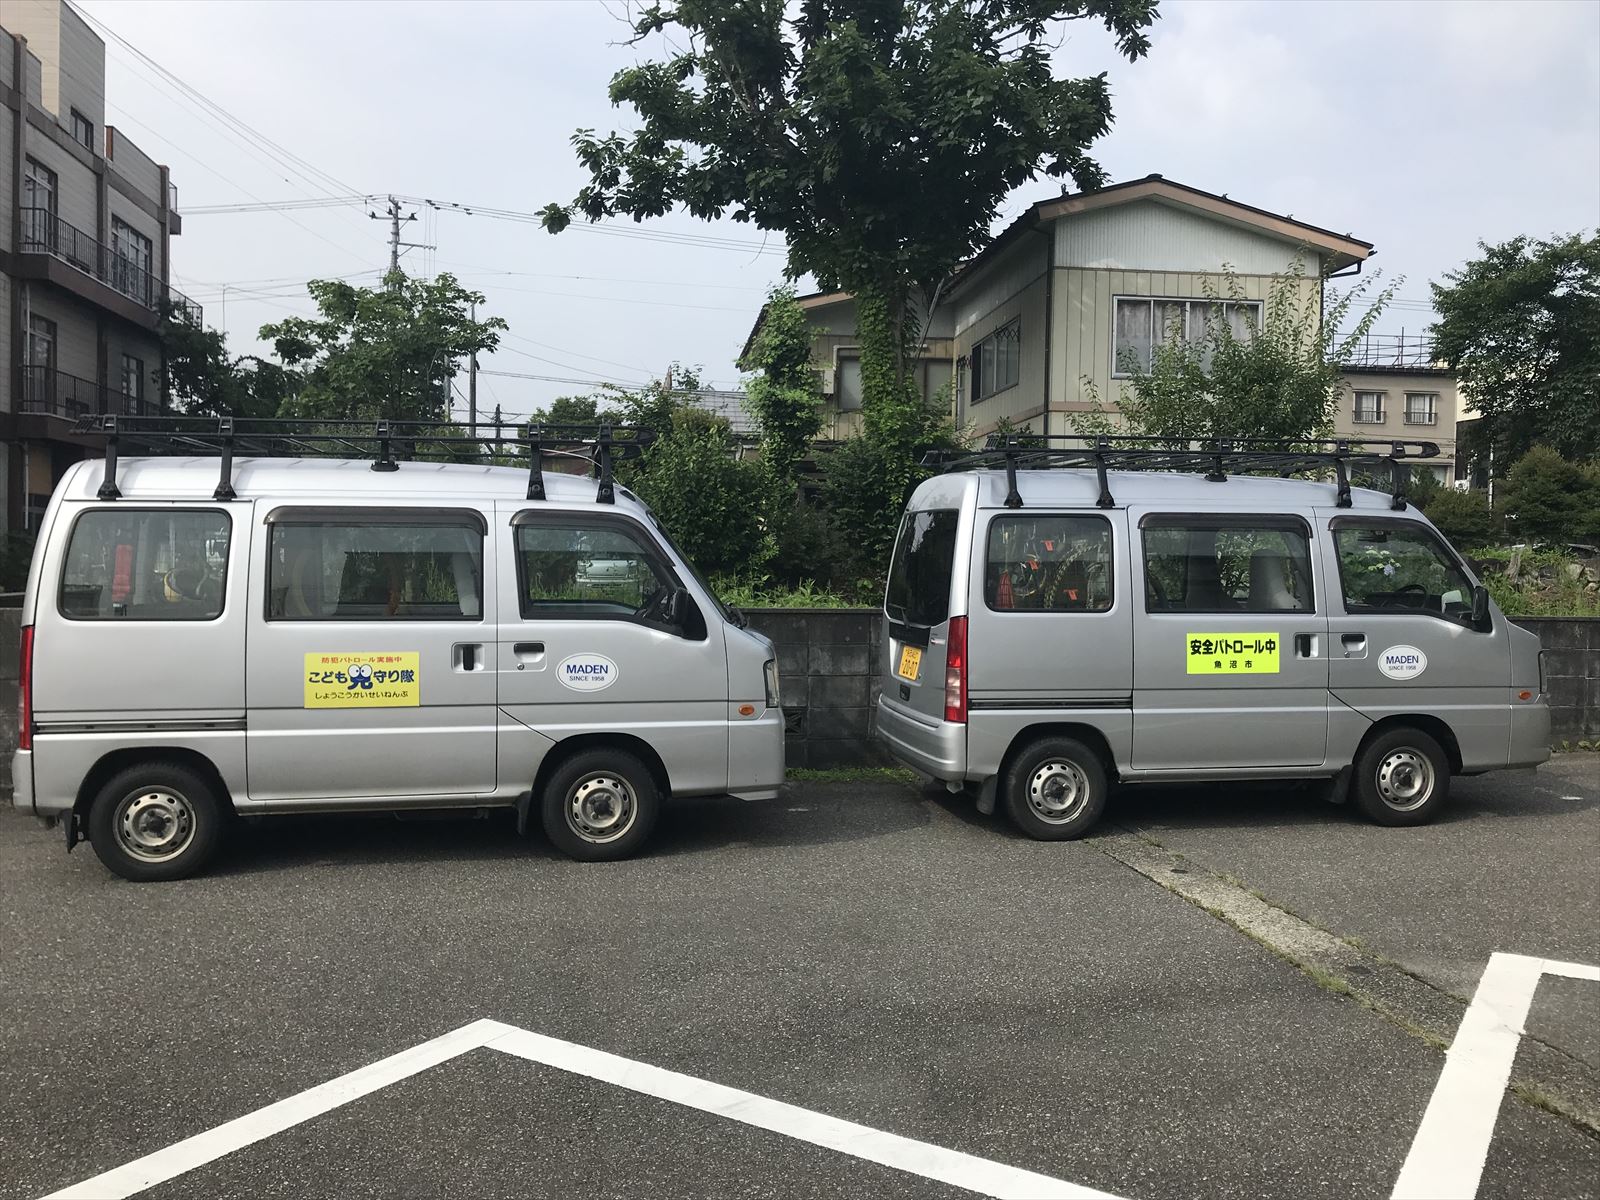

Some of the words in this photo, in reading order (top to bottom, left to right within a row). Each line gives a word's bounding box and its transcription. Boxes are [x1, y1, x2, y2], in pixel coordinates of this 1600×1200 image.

[1190, 639, 1276, 655] 安全パトロール中
[321, 656, 402, 664] 防犯パトロール実施中
[1386, 655, 1419, 664] MADEN
[566, 664, 608, 674] MADEN
[315, 691, 408, 700] しょうこうかいせいねんぶ
